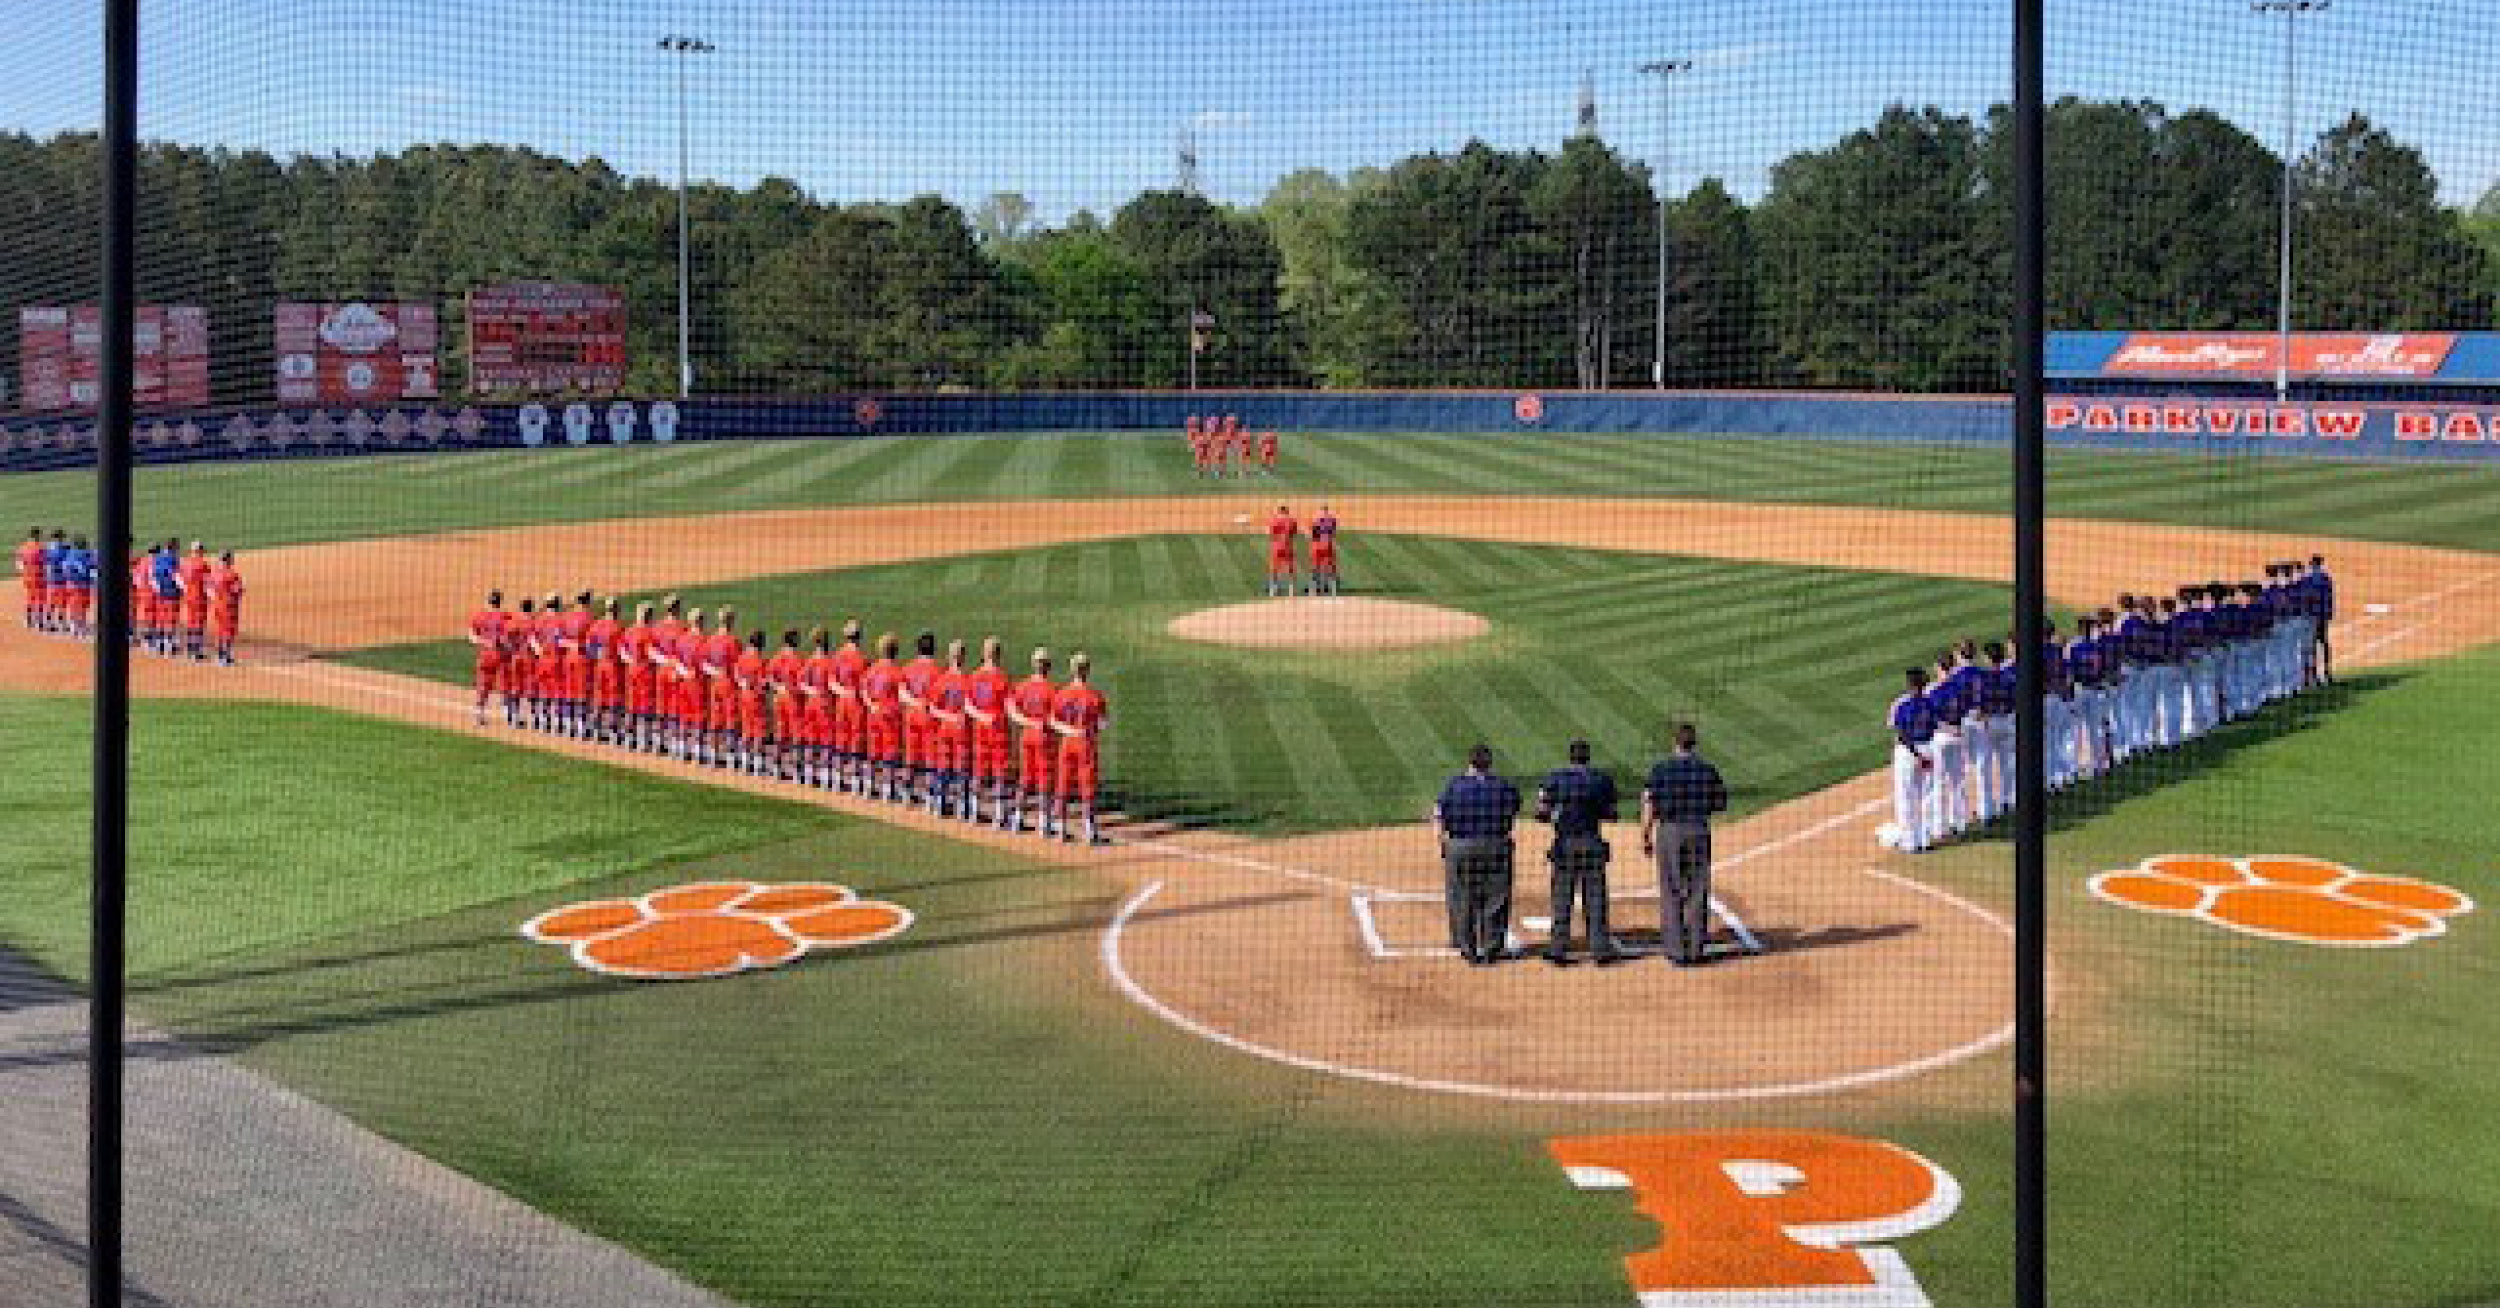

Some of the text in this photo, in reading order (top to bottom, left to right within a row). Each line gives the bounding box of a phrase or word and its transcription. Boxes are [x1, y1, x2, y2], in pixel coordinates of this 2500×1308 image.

[2046, 404, 2500, 440] PARKVIEW BA
[1546, 1128, 1963, 1308] P
